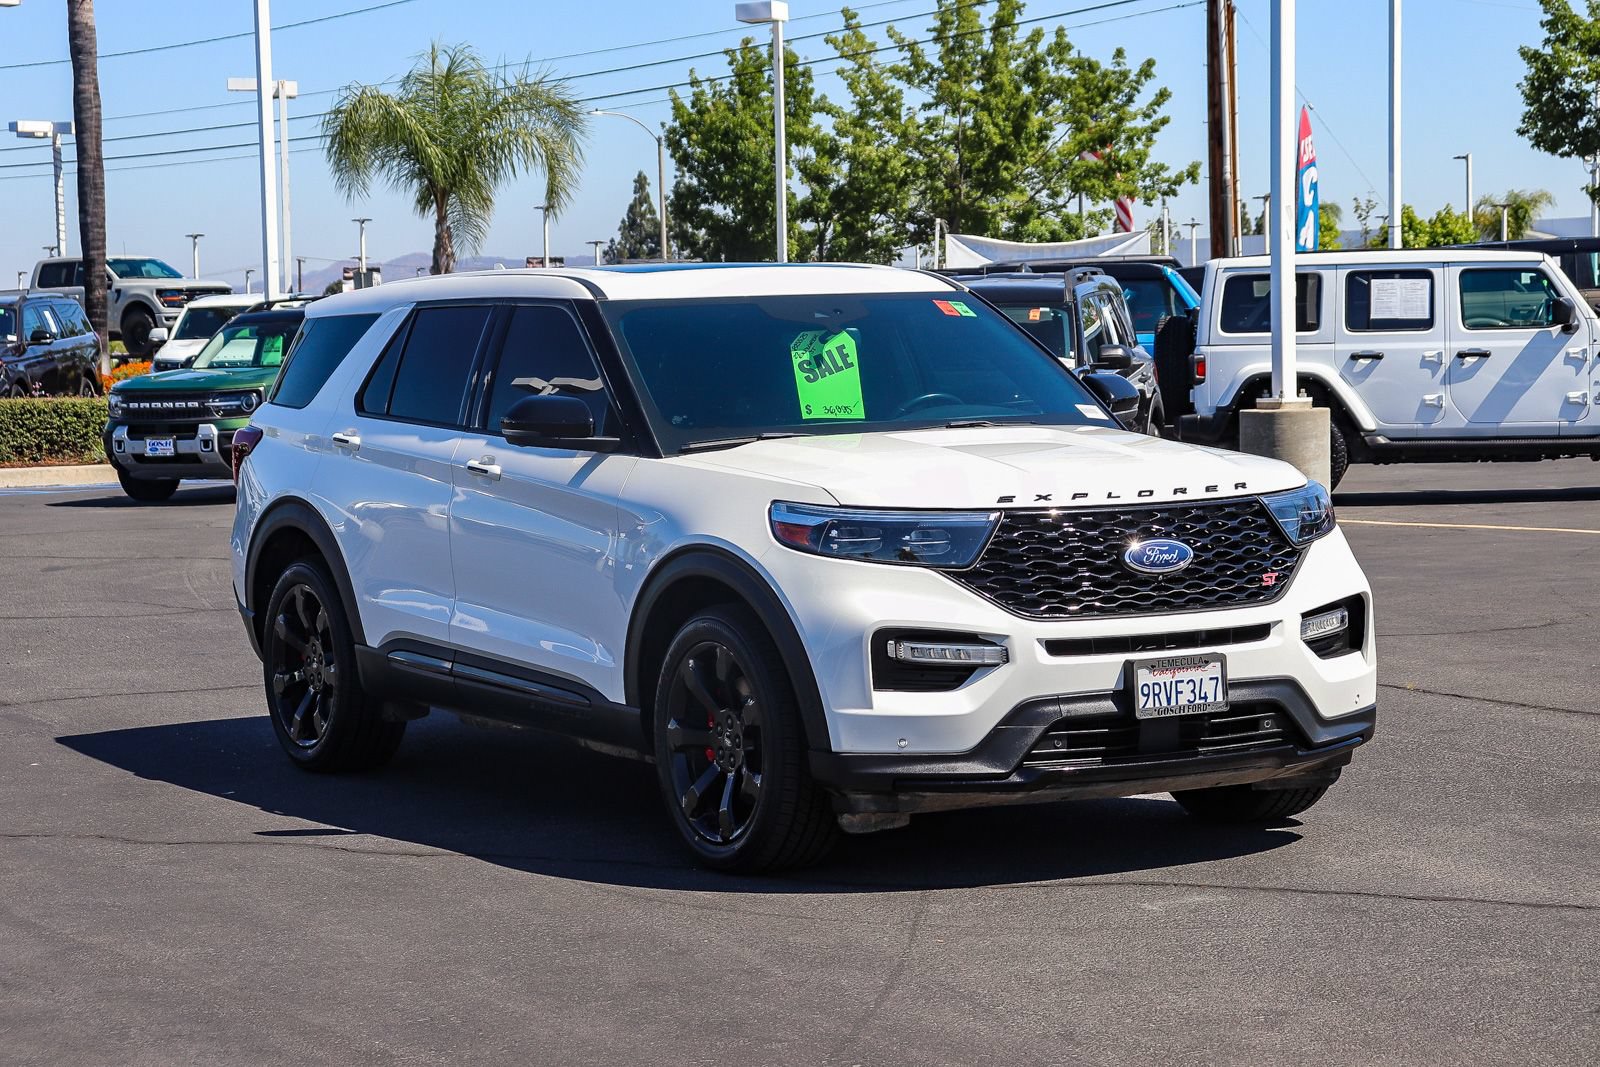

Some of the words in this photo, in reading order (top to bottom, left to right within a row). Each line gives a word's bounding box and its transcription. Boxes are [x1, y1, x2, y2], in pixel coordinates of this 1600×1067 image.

[798, 344, 854, 383] SALE
[129, 401, 199, 409] BRONCO
[804, 403, 812, 415] $
[997, 482, 1247, 503] EXPLORER
[1143, 545, 1179, 564] Ford
[1262, 572, 1279, 586] ST
[1157, 656, 1204, 668] TEMECULA
[1141, 676, 1219, 708] 9RVF347
[1187, 703, 1208, 714] FORD
